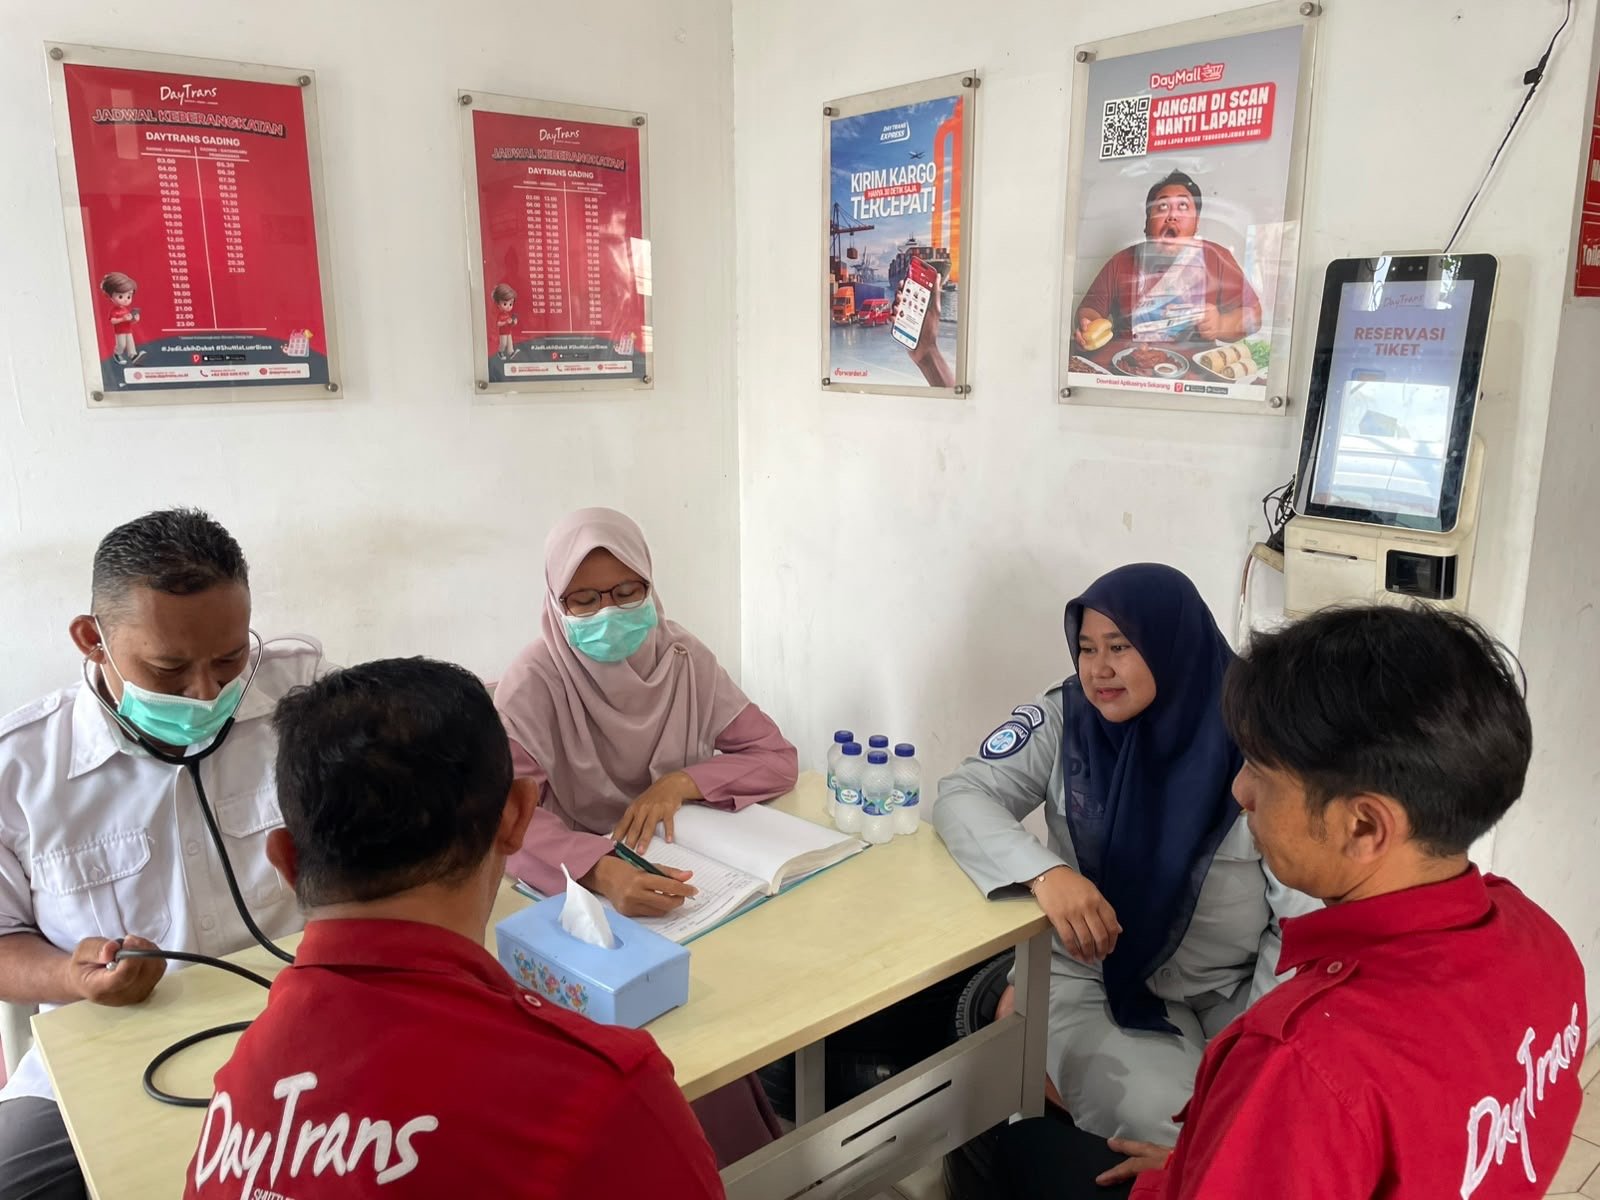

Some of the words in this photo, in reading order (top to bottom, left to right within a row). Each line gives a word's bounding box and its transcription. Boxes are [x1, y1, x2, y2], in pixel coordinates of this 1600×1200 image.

[1151, 66, 1201, 90] DayMall
[160, 84, 217, 105] DayTrans
[1153, 95, 1207, 118] JANGAN
[1211, 92, 1225, 111] DI
[1229, 86, 1270, 108] SCAN
[92, 108, 159, 124] JADWAL
[158, 111, 286, 137] KEBERANGKATAN
[1155, 113, 1197, 136] NANTI
[1200, 106, 1262, 131] LAPAR!!!
[146, 132, 201, 144] DAYTRANS
[202, 136, 240, 147] GADING
[539, 127, 580, 145] DayTrans
[880, 129, 906, 140] EXPRESS
[528, 167, 567, 178] DAYTRANS
[567, 170, 594, 179] GADING
[851, 170, 886, 193] KIRIM
[889, 163, 936, 187] KARGO
[851, 187, 936, 219] TERCEPAT!
[1353, 327, 1446, 341] RESERVASI
[1374, 343, 1420, 356] TIKET
[195, 1071, 439, 1200] DayTrans
